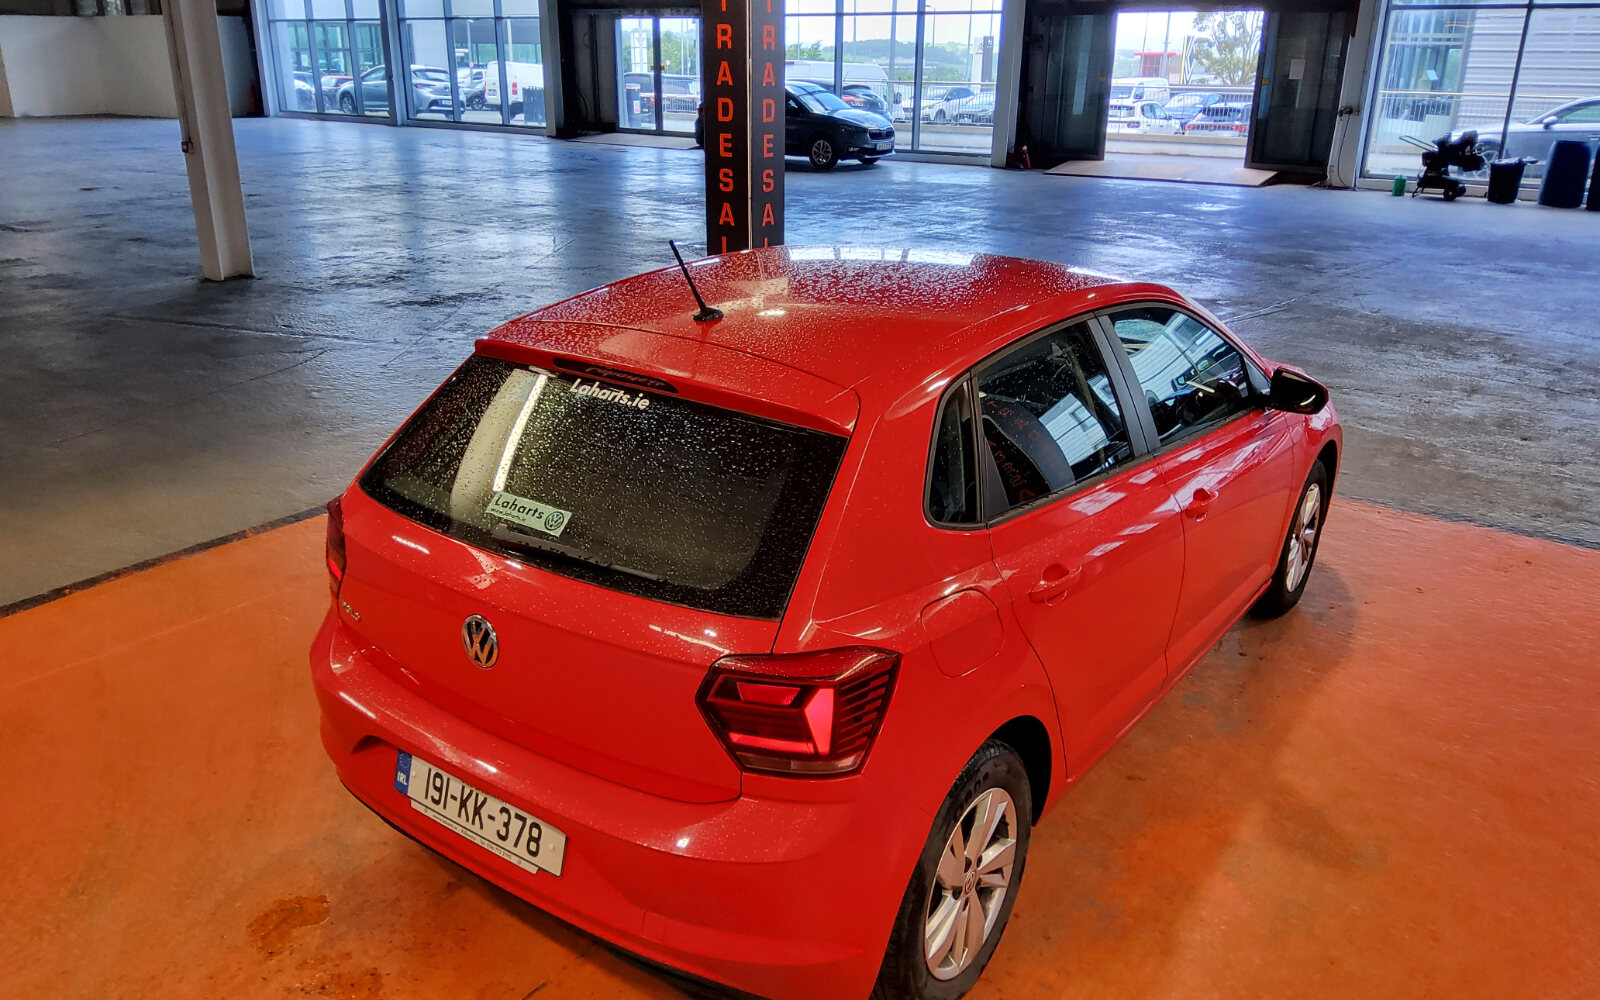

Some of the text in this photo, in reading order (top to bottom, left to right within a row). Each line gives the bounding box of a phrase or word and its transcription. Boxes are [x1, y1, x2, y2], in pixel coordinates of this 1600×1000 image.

[569, 379, 650, 410] Laharts.ie
[494, 494, 545, 520] Laharts
[397, 771, 408, 786] IRL
[424, 767, 543, 858] 191-KK-378
